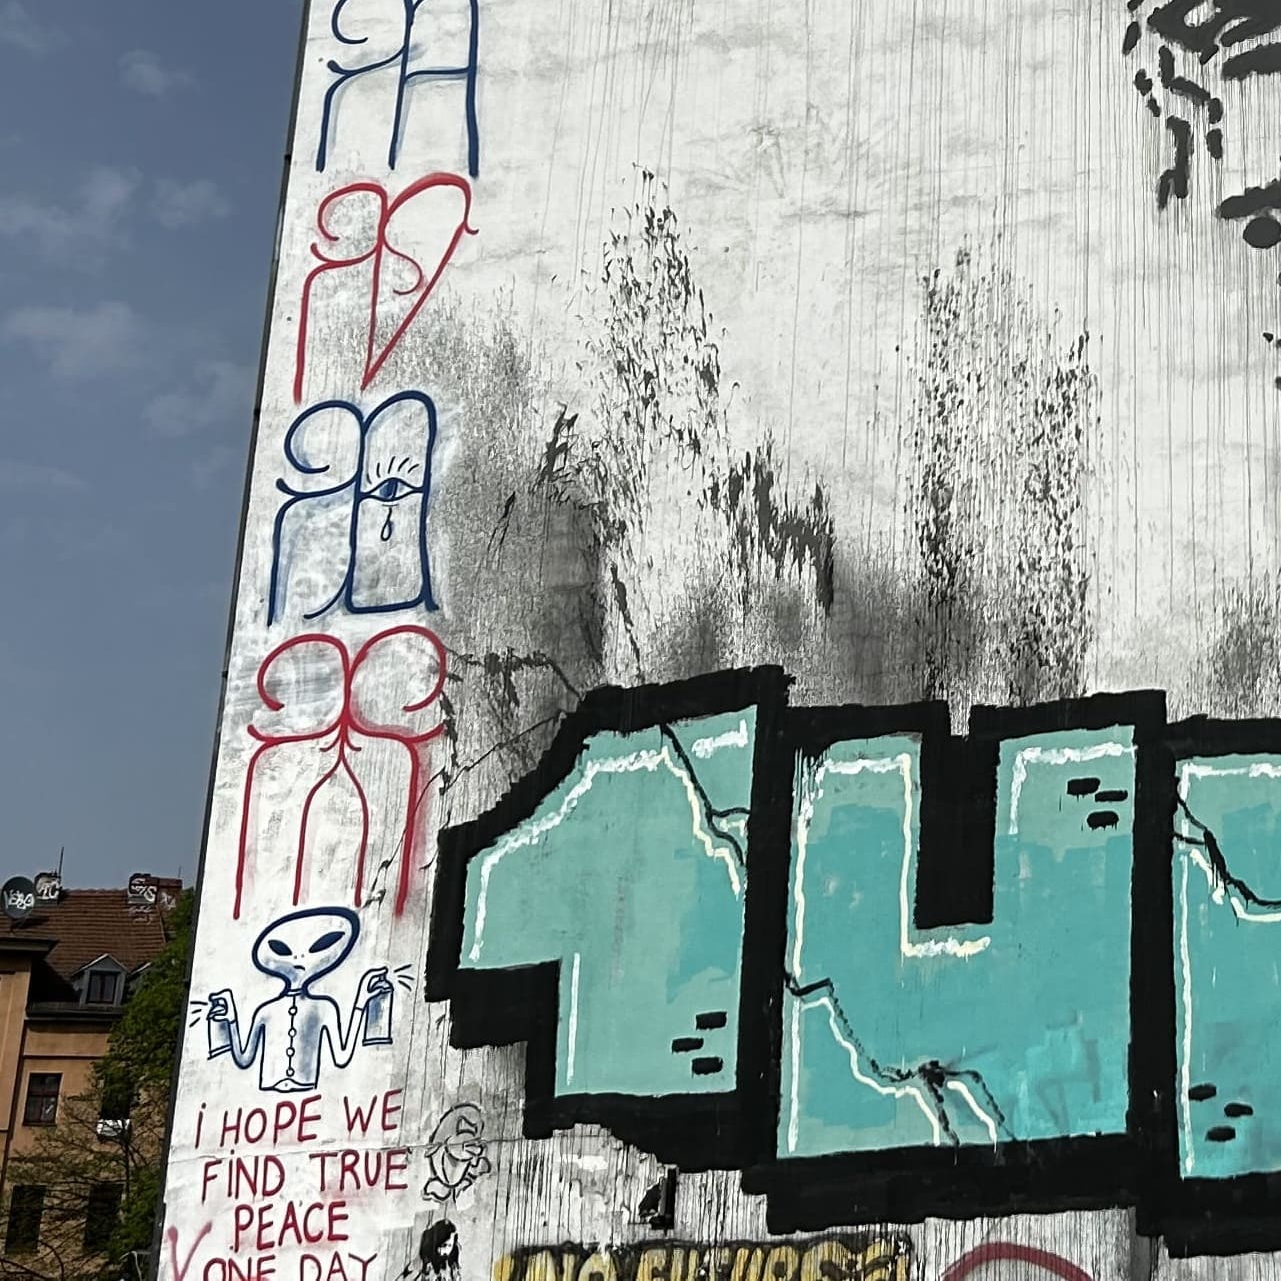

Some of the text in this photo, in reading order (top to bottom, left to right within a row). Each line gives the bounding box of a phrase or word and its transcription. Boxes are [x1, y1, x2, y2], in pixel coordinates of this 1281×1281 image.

[220, 1095, 322, 1147] HOPE
[343, 1089, 403, 1133] WE
[309, 1149, 408, 1191] TRUE
[234, 1201, 349, 1253] PEACE
